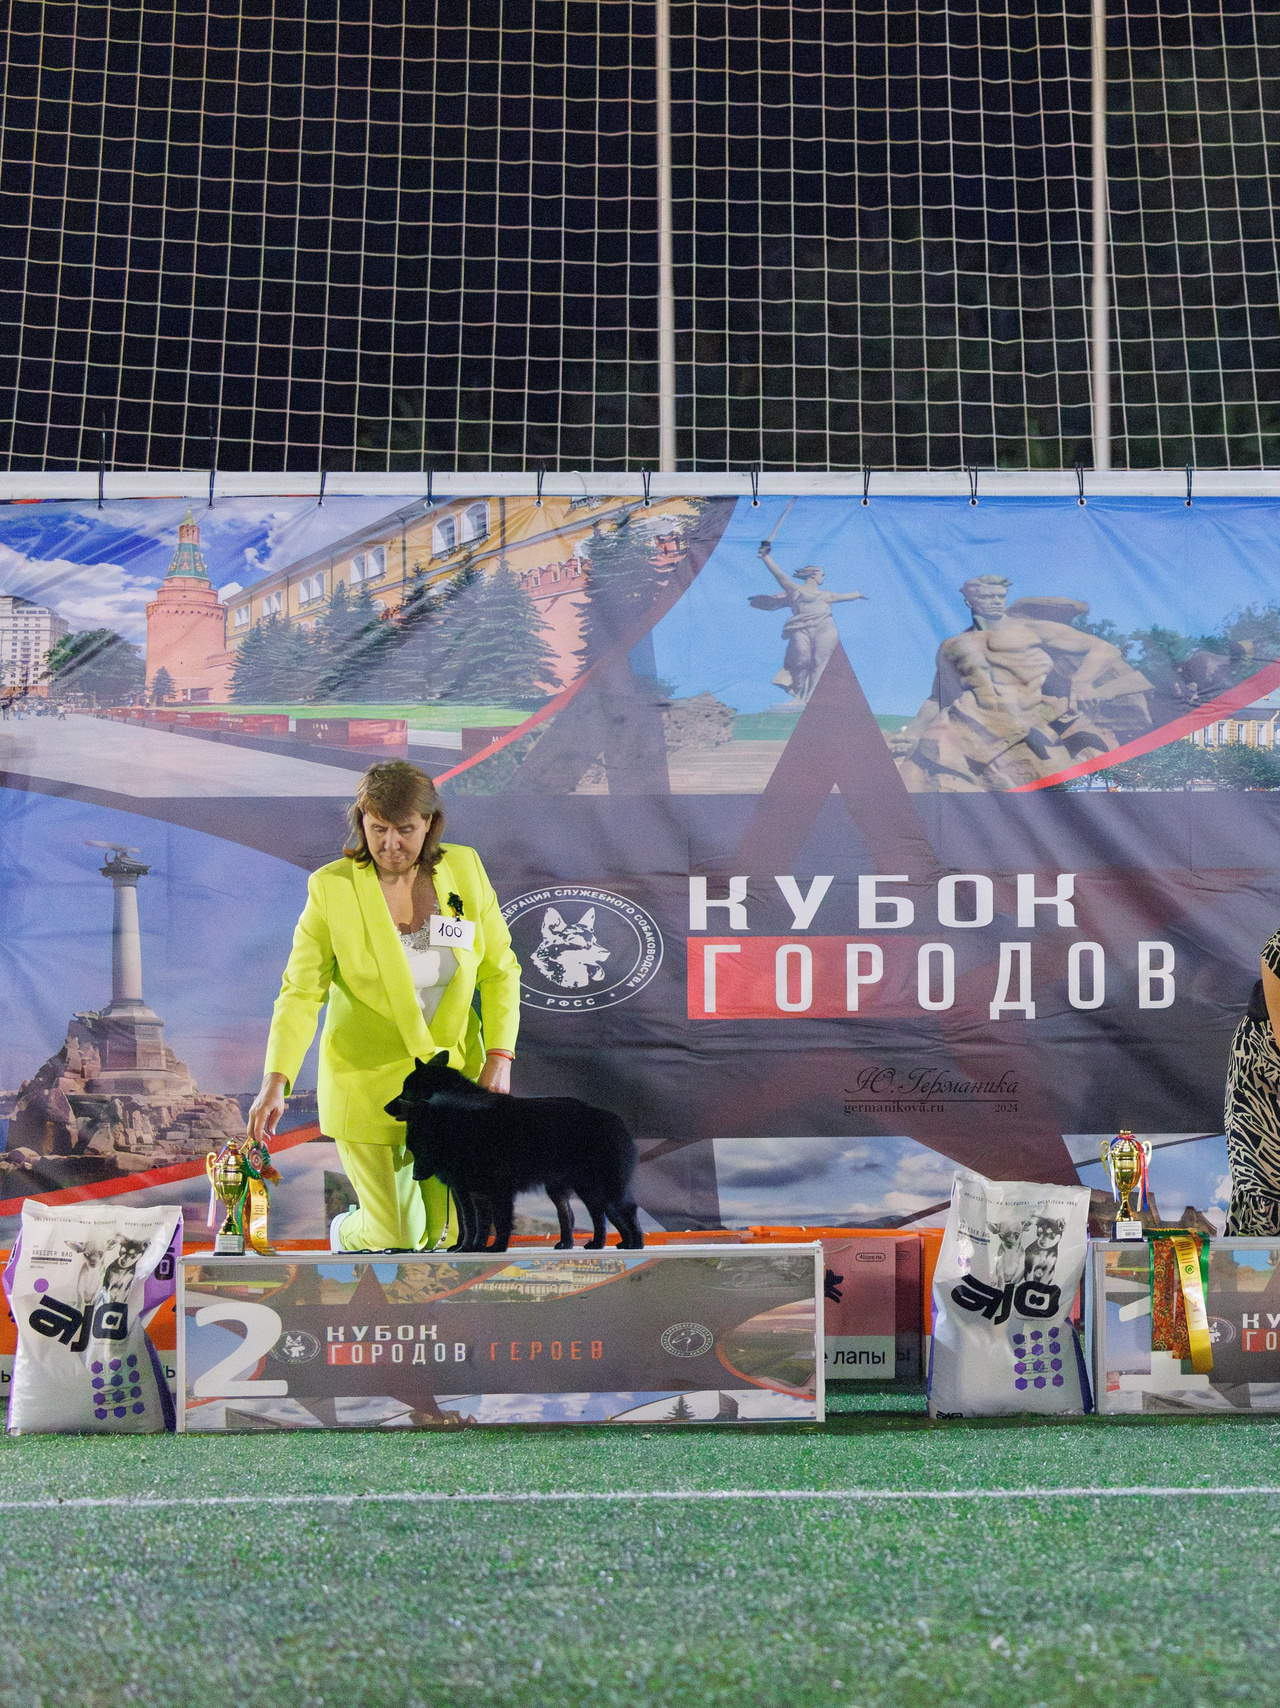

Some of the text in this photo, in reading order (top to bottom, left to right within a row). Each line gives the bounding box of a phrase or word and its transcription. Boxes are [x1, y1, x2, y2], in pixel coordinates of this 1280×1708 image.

[688, 873, 1079, 931] КУБОК
[438, 922, 463, 938] 100
[503, 889, 656, 988] ДЕРАЦИЯ СЛУЖЕБНОГО СОБАКОВОДСТВА
[703, 940, 1176, 1020] ГОРОДОВ
[546, 998, 595, 1007] РФСС
[327, 1324, 438, 1342] КУБОК
[193, 1302, 288, 1397] 2
[331, 1342, 467, 1365] ГОРОДОВ
[490, 1340, 603, 1361] ГЕРОЕВ
[833, 1350, 886, 1366] лапы
